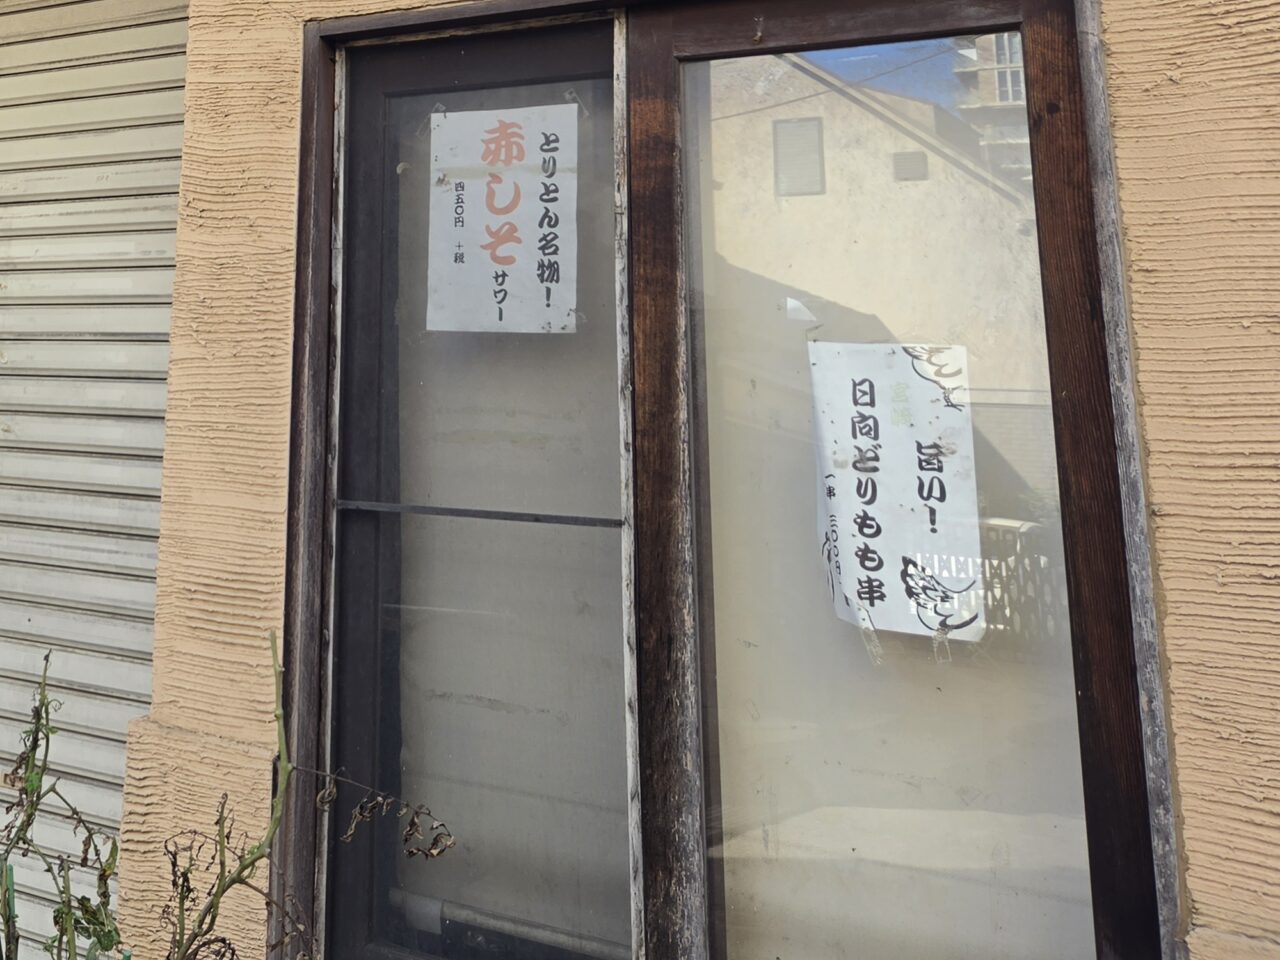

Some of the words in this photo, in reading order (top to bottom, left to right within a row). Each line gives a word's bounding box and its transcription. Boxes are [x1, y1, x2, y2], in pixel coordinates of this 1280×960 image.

[850, 378, 887, 608] 日向どりもも串
